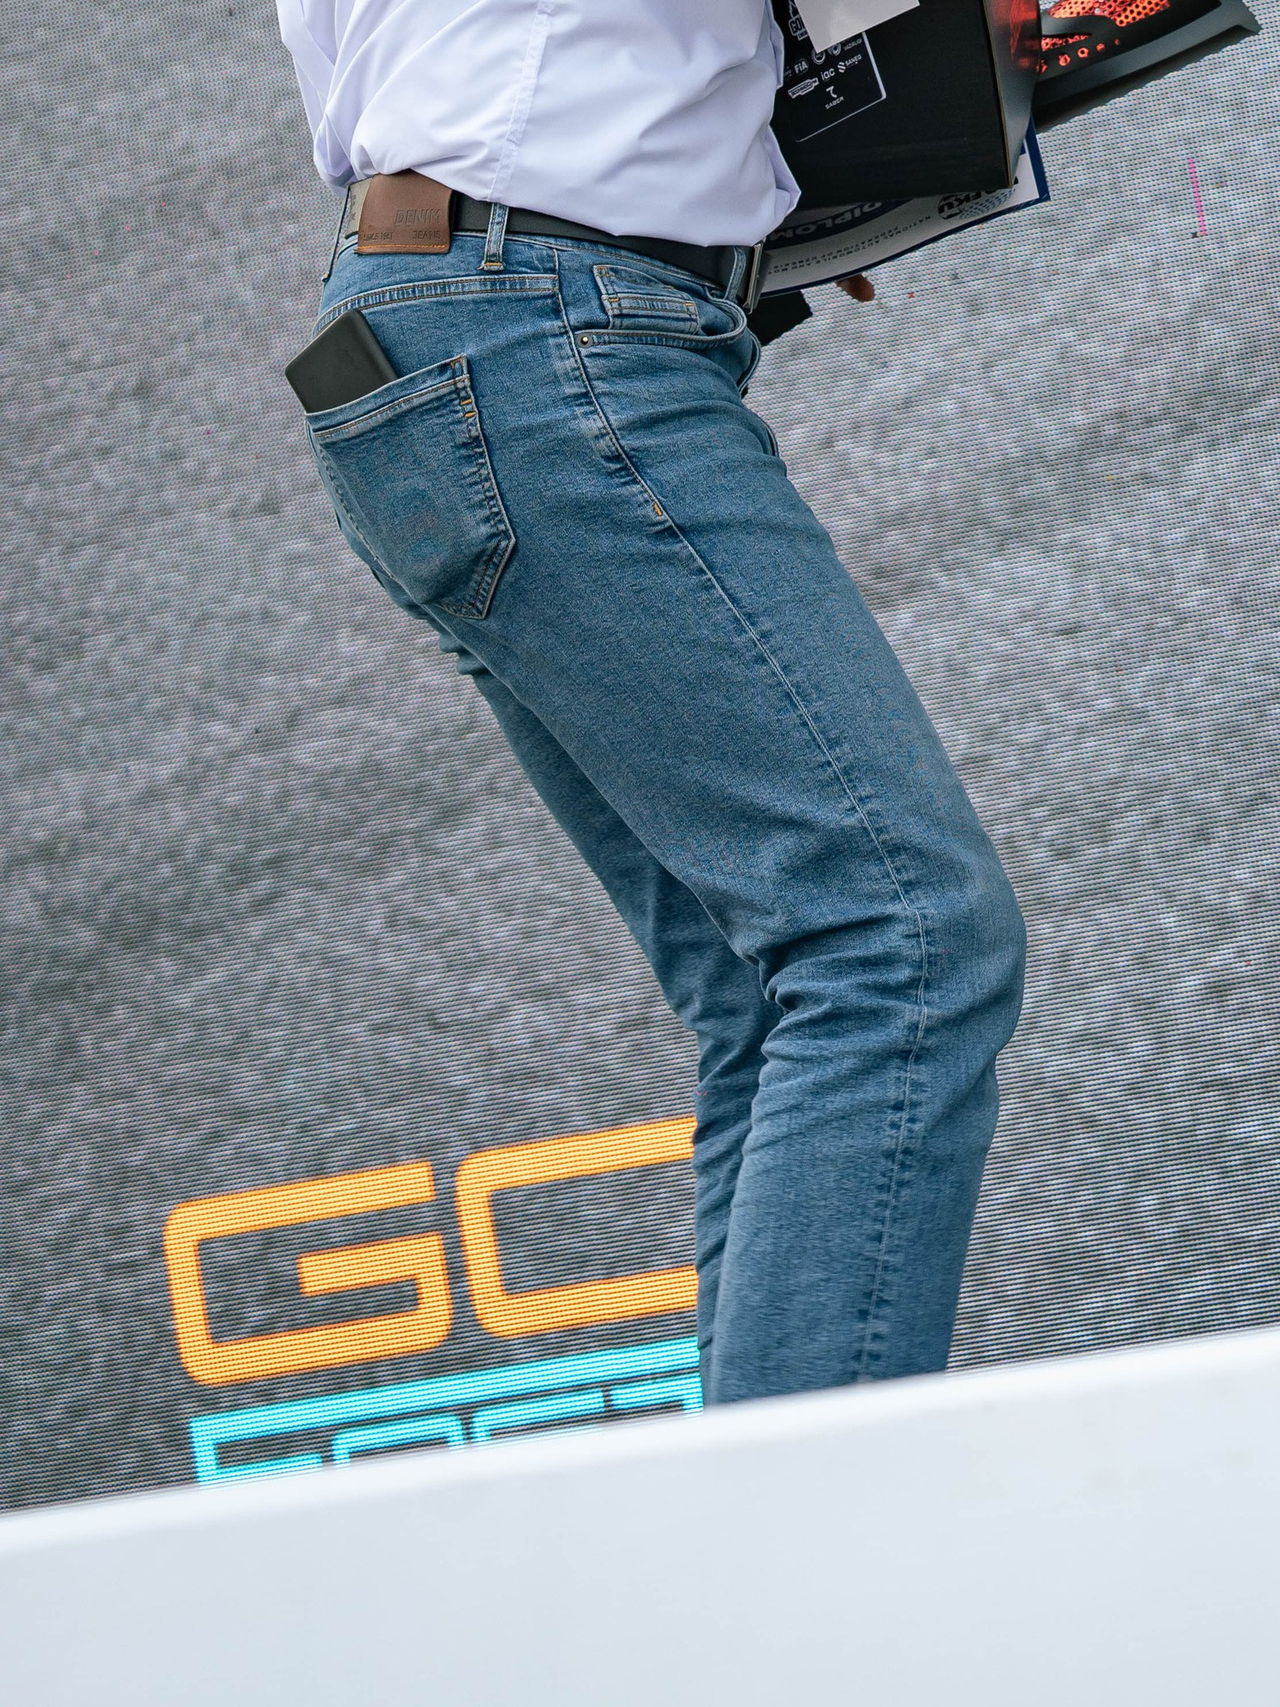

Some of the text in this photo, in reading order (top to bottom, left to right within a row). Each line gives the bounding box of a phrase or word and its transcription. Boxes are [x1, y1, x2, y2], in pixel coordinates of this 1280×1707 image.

[825, 96, 844, 109] SABER
[394, 208, 441, 226] DENIM
[412, 230, 441, 240] JEANS
[883, 215, 931, 239] NATIONAL
[836, 226, 898, 253] FEDERATION
[815, 239, 880, 264] AUTOMOBILE
[773, 255, 817, 269] UZBEKIS
[791, 261, 811, 270] AND
